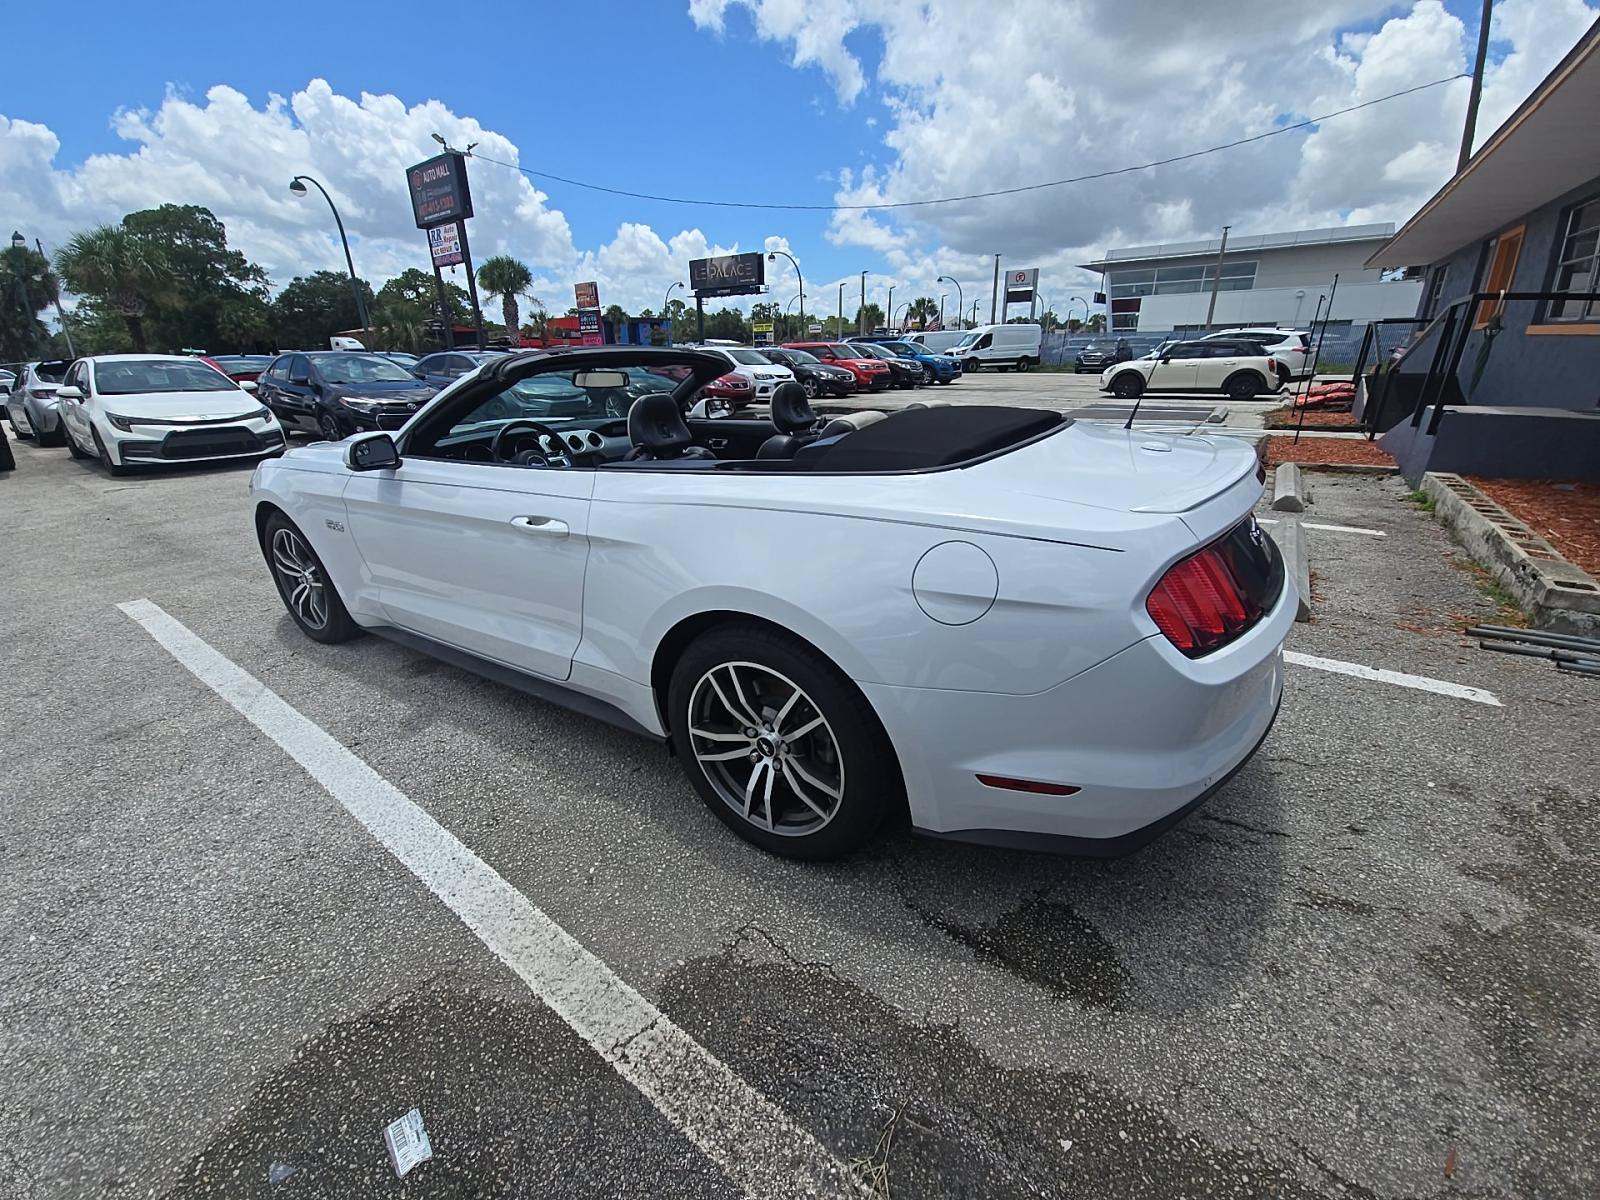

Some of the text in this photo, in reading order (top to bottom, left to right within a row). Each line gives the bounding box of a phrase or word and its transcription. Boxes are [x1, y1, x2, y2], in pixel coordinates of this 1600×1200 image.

[423, 164, 449, 183] AUTO MALL
[709, 262, 753, 279] PALACE
